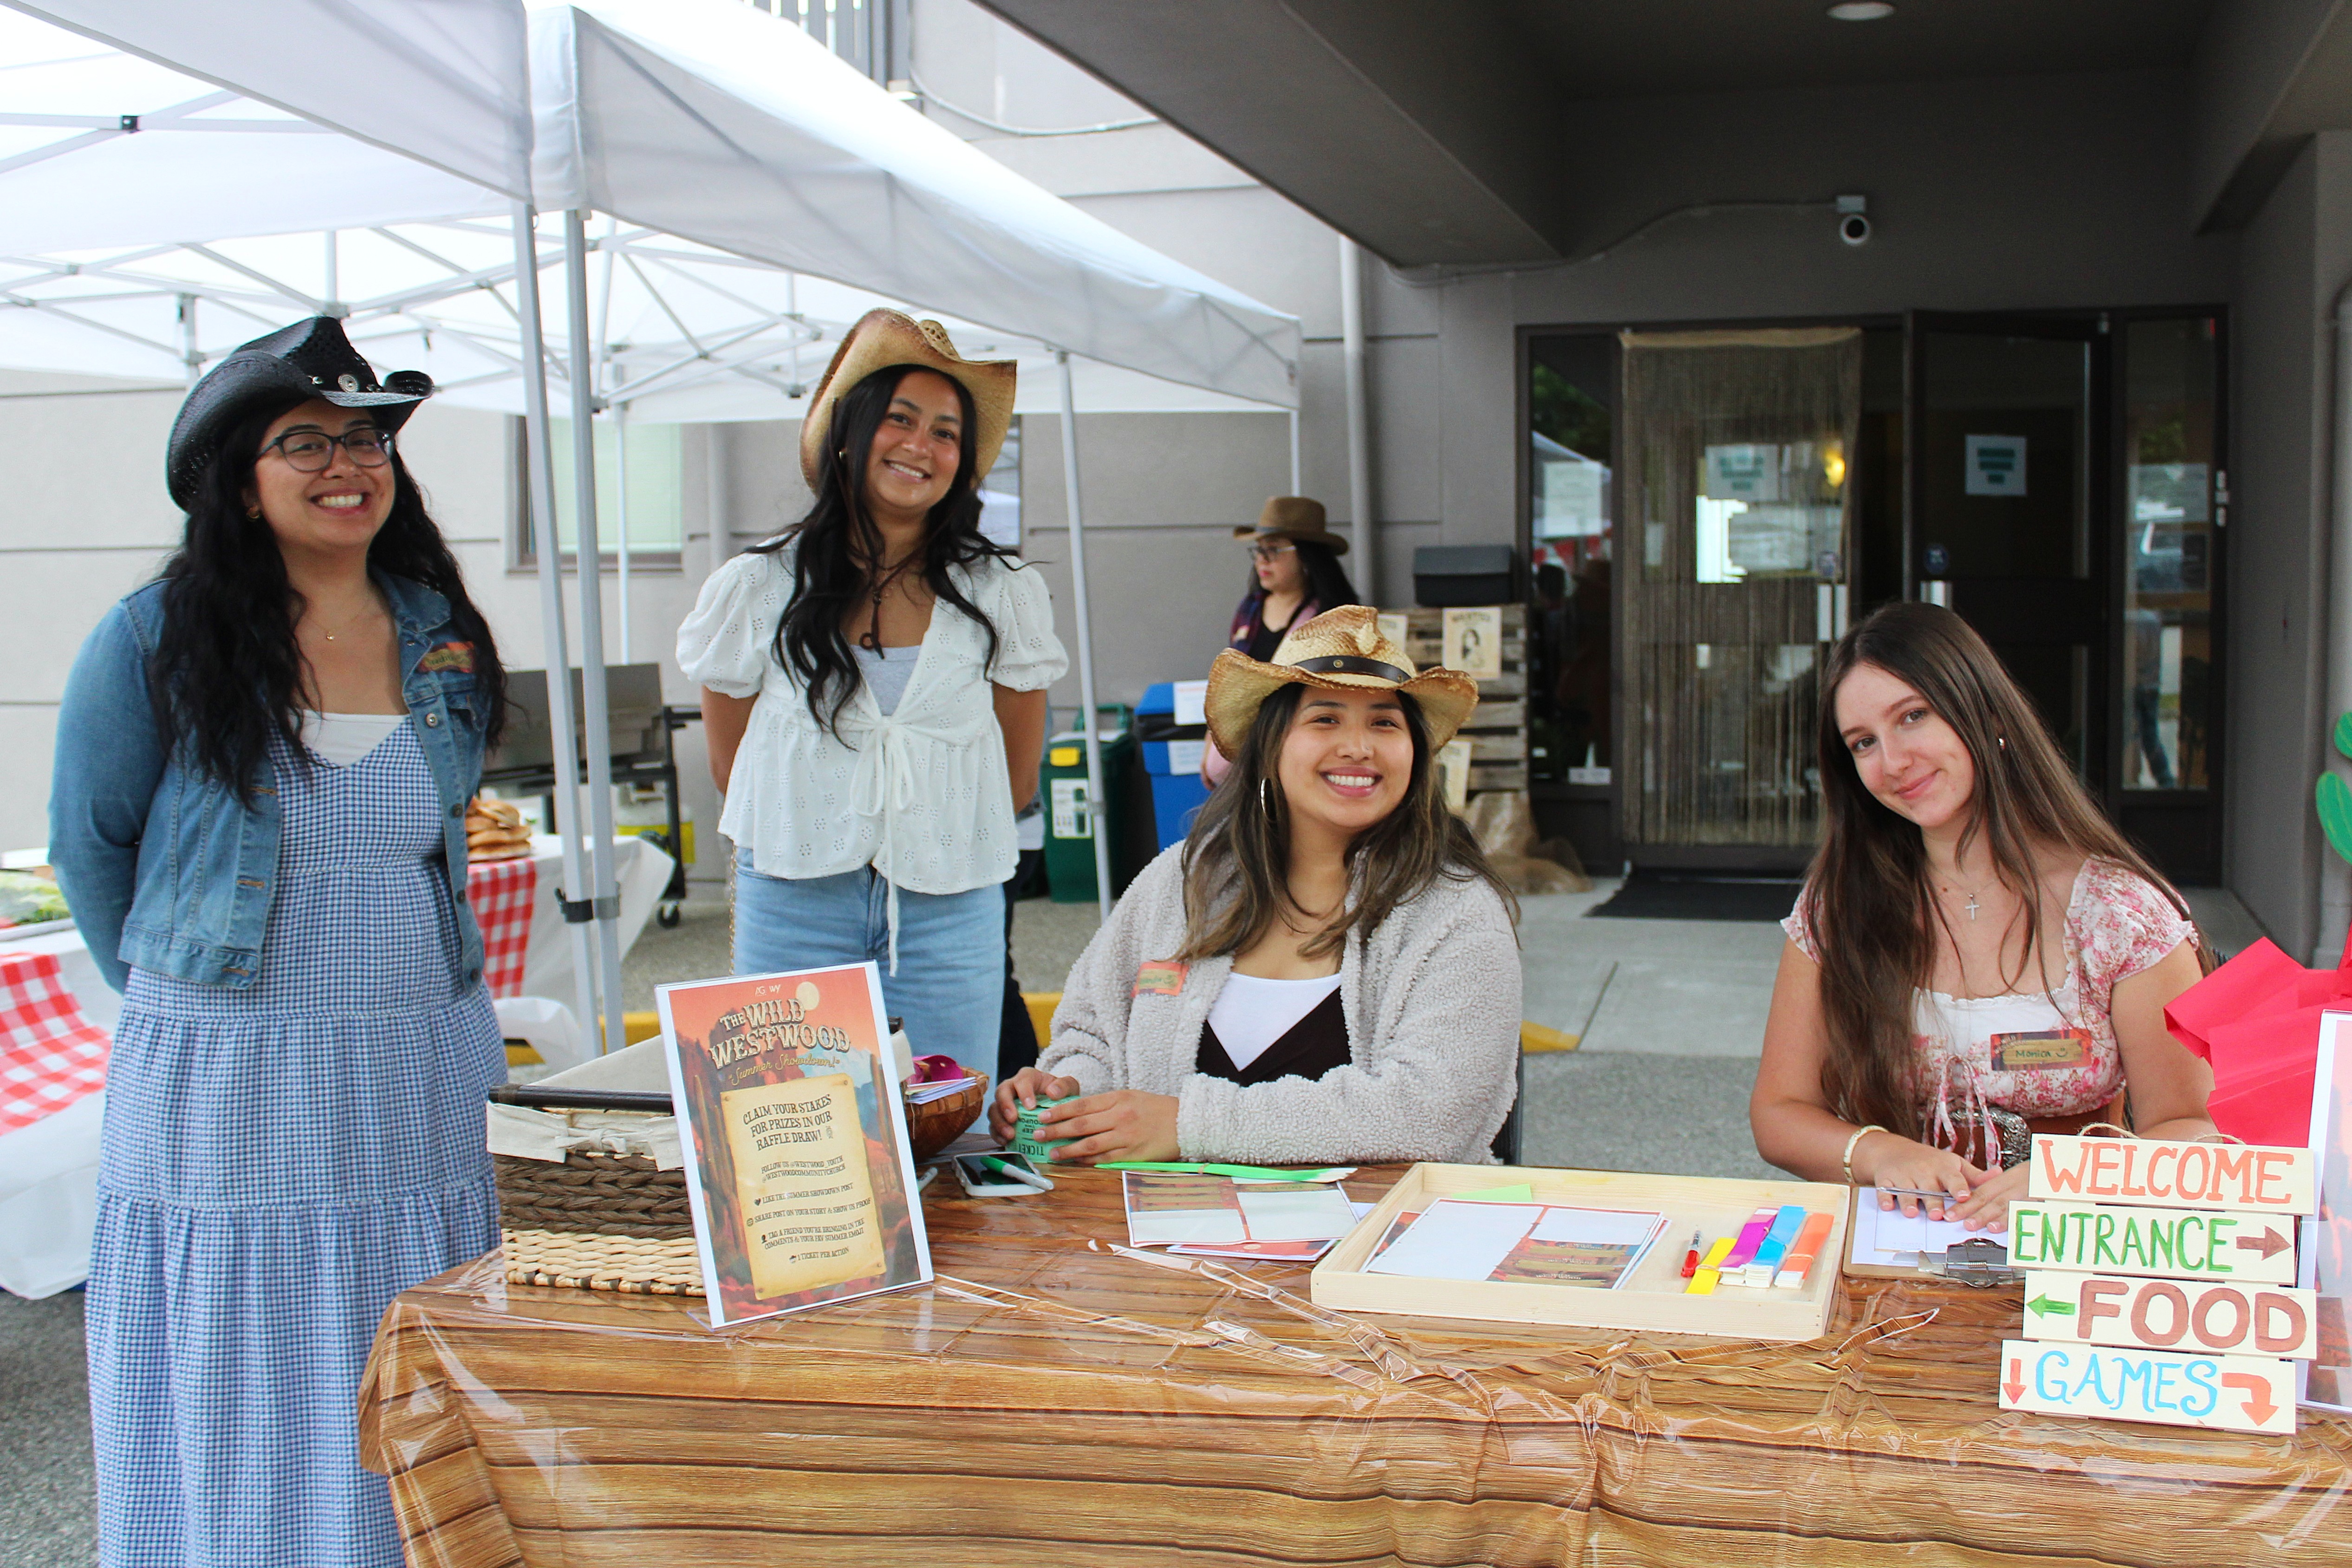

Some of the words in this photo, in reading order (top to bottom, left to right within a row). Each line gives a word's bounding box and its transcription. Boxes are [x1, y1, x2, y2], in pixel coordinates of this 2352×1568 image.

[719, 1012, 746, 1031] THE
[743, 999, 806, 1028] WILD
[708, 1024, 851, 1070] WESTWOOD
[731, 1061, 772, 1086] Summer
[775, 1053, 835, 1070] Showdown!
[743, 1106, 772, 1125] CLAIM
[773, 1103, 798, 1114] YOUR
[798, 1094, 832, 1113] STAKES
[750, 1121, 768, 1138] FOR
[768, 1118, 801, 1130] PRIZES
[802, 1117, 813, 1127] IN
[814, 1111, 832, 1126] OUR
[756, 1133, 791, 1151] RAFFLE
[792, 1129, 822, 1143] DRAW!
[1019, 1144, 1045, 1156] TICKET
[761, 1162, 781, 1174] FOLLOW
[2038, 1139, 2295, 1204] WELCOME
[762, 1195, 775, 1204] LIKE
[810, 1186, 840, 1197] SHOWDOWN
[840, 1183, 853, 1192] POST
[754, 1212, 772, 1223] SHARE
[833, 1205, 848, 1213] SHOW
[856, 1197, 871, 1209] PROOF
[765, 1236, 794, 1249] COMMENTS
[825, 1233, 848, 1242] SUMMER
[848, 1227, 864, 1238] EMOJI
[768, 1230, 778, 1239] TAG
[822, 1224, 847, 1233] BRINGING
[854, 1217, 864, 1227] THE
[2014, 1210, 2237, 1272] ENTRANCE
[831, 1246, 849, 1257] ACTION
[2077, 1279, 2307, 1353] FOOD
[2035, 1349, 2217, 1417] GAMES
